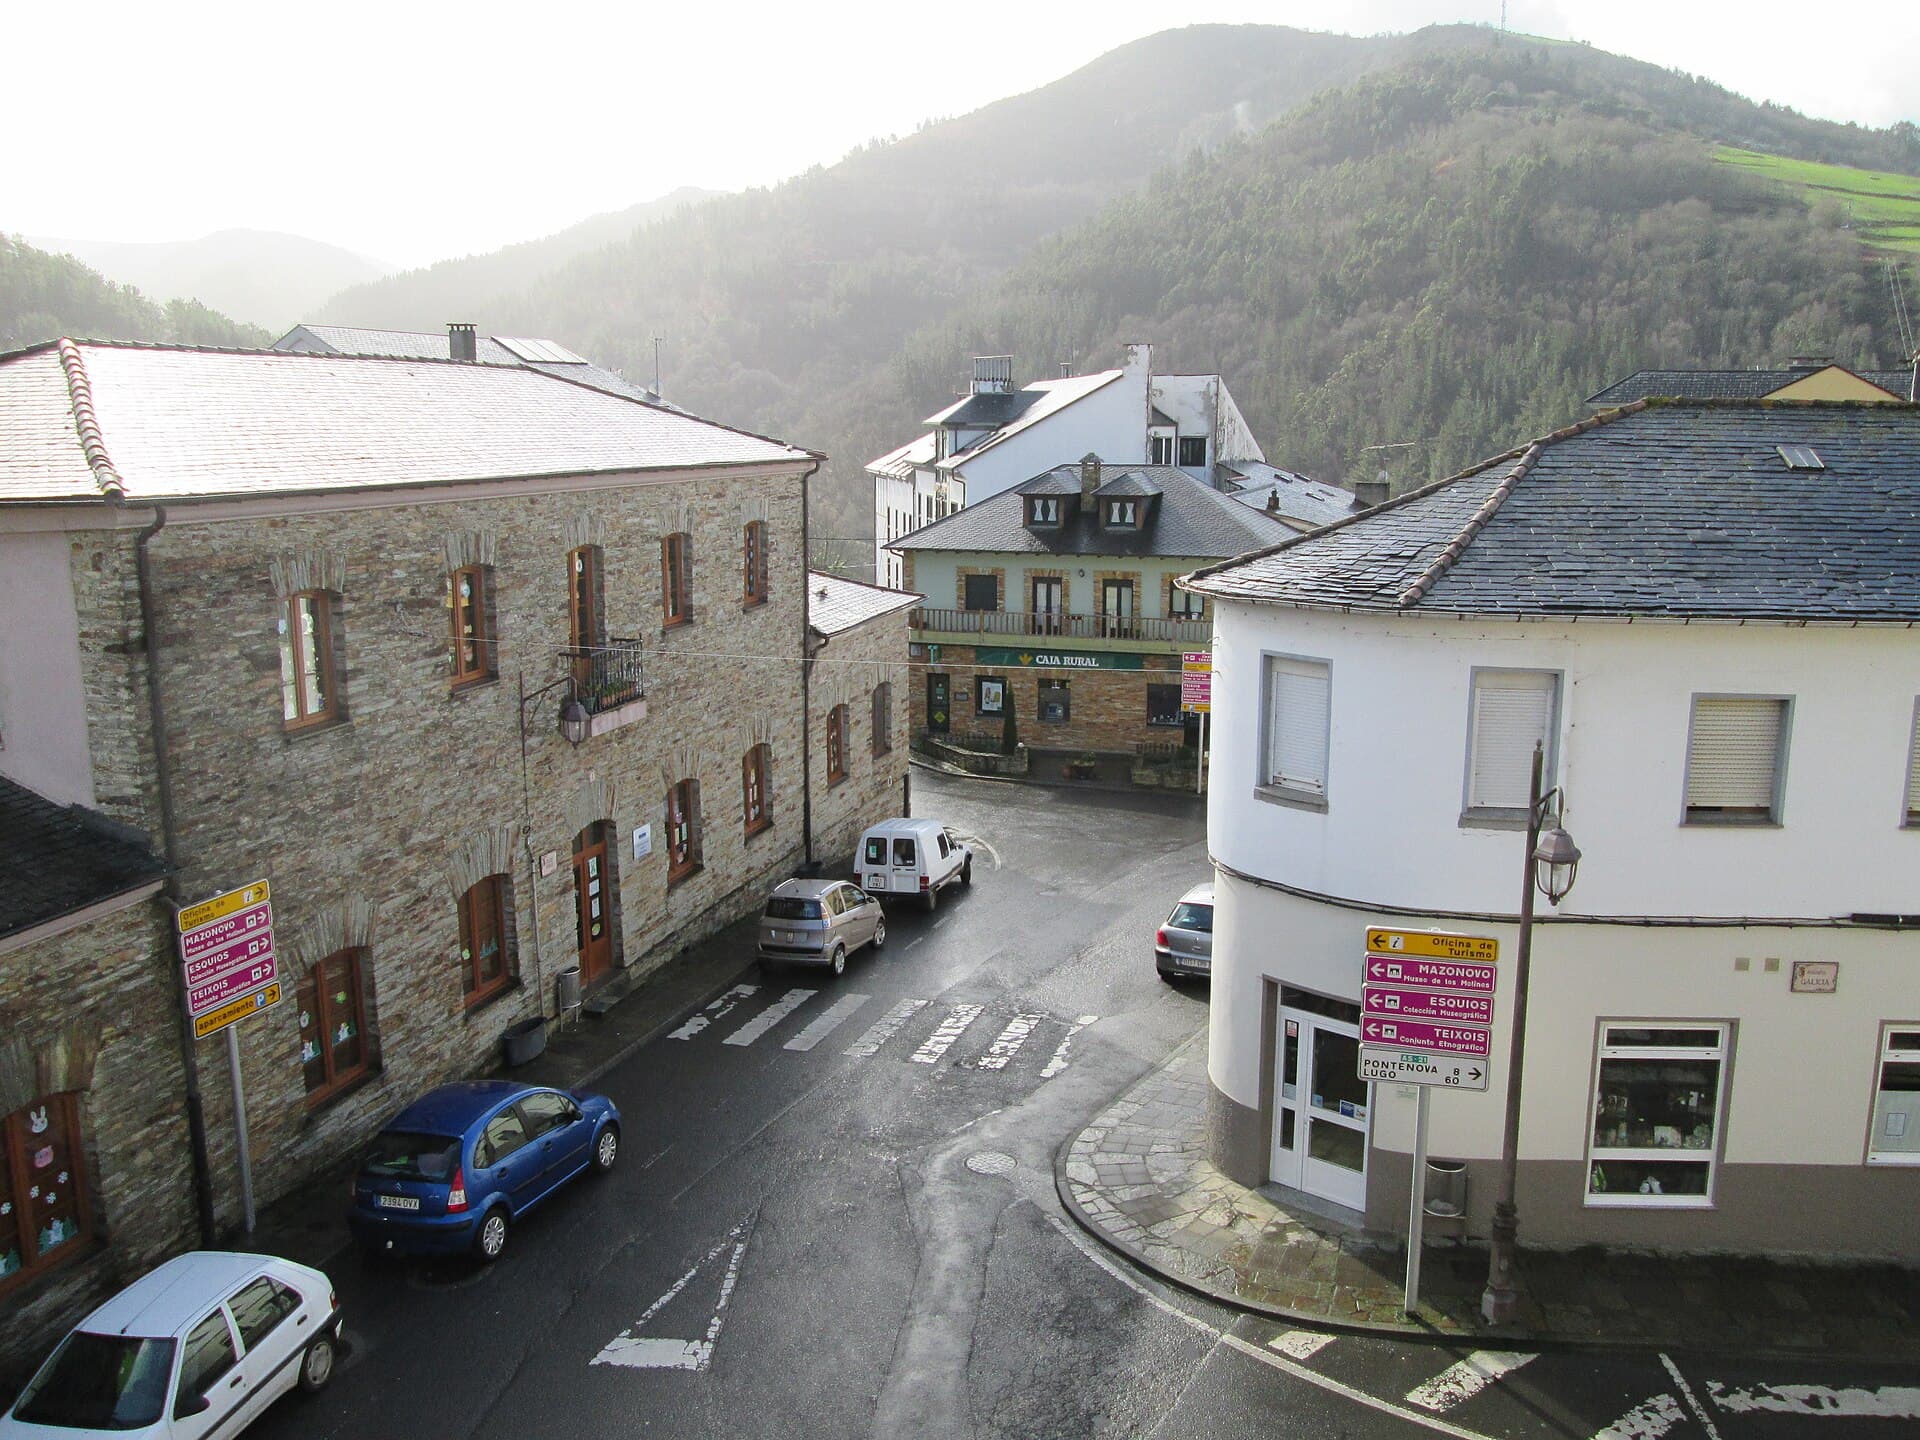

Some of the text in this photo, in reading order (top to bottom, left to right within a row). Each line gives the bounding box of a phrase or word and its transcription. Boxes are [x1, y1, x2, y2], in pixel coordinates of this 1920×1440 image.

[1063, 656, 1099, 667] RURAL
[183, 904, 211, 921] Oficina
[215, 900, 225, 909] de
[185, 920, 235, 947] MAZONOVO
[1432, 937, 1472, 948] Oficina
[1479, 941, 1493, 950] de
[1448, 947, 1492, 959] Turismo
[189, 951, 230, 974] ESQUIOS
[1418, 964, 1491, 979] MAZONOVO
[1403, 975, 1490, 989] Museo de los Molinos
[192, 979, 229, 1001] TEIXOIS
[1430, 996, 1489, 1010] ESQUIOS
[199, 1000, 255, 1030] aparcamiento
[1399, 1035, 1435, 1046] Conjunto
[1433, 1028, 1486, 1042] TEIXOIS
[1364, 1059, 1461, 1076] PONTENOVA 8
[1363, 1069, 1460, 1085] LUGO 60
